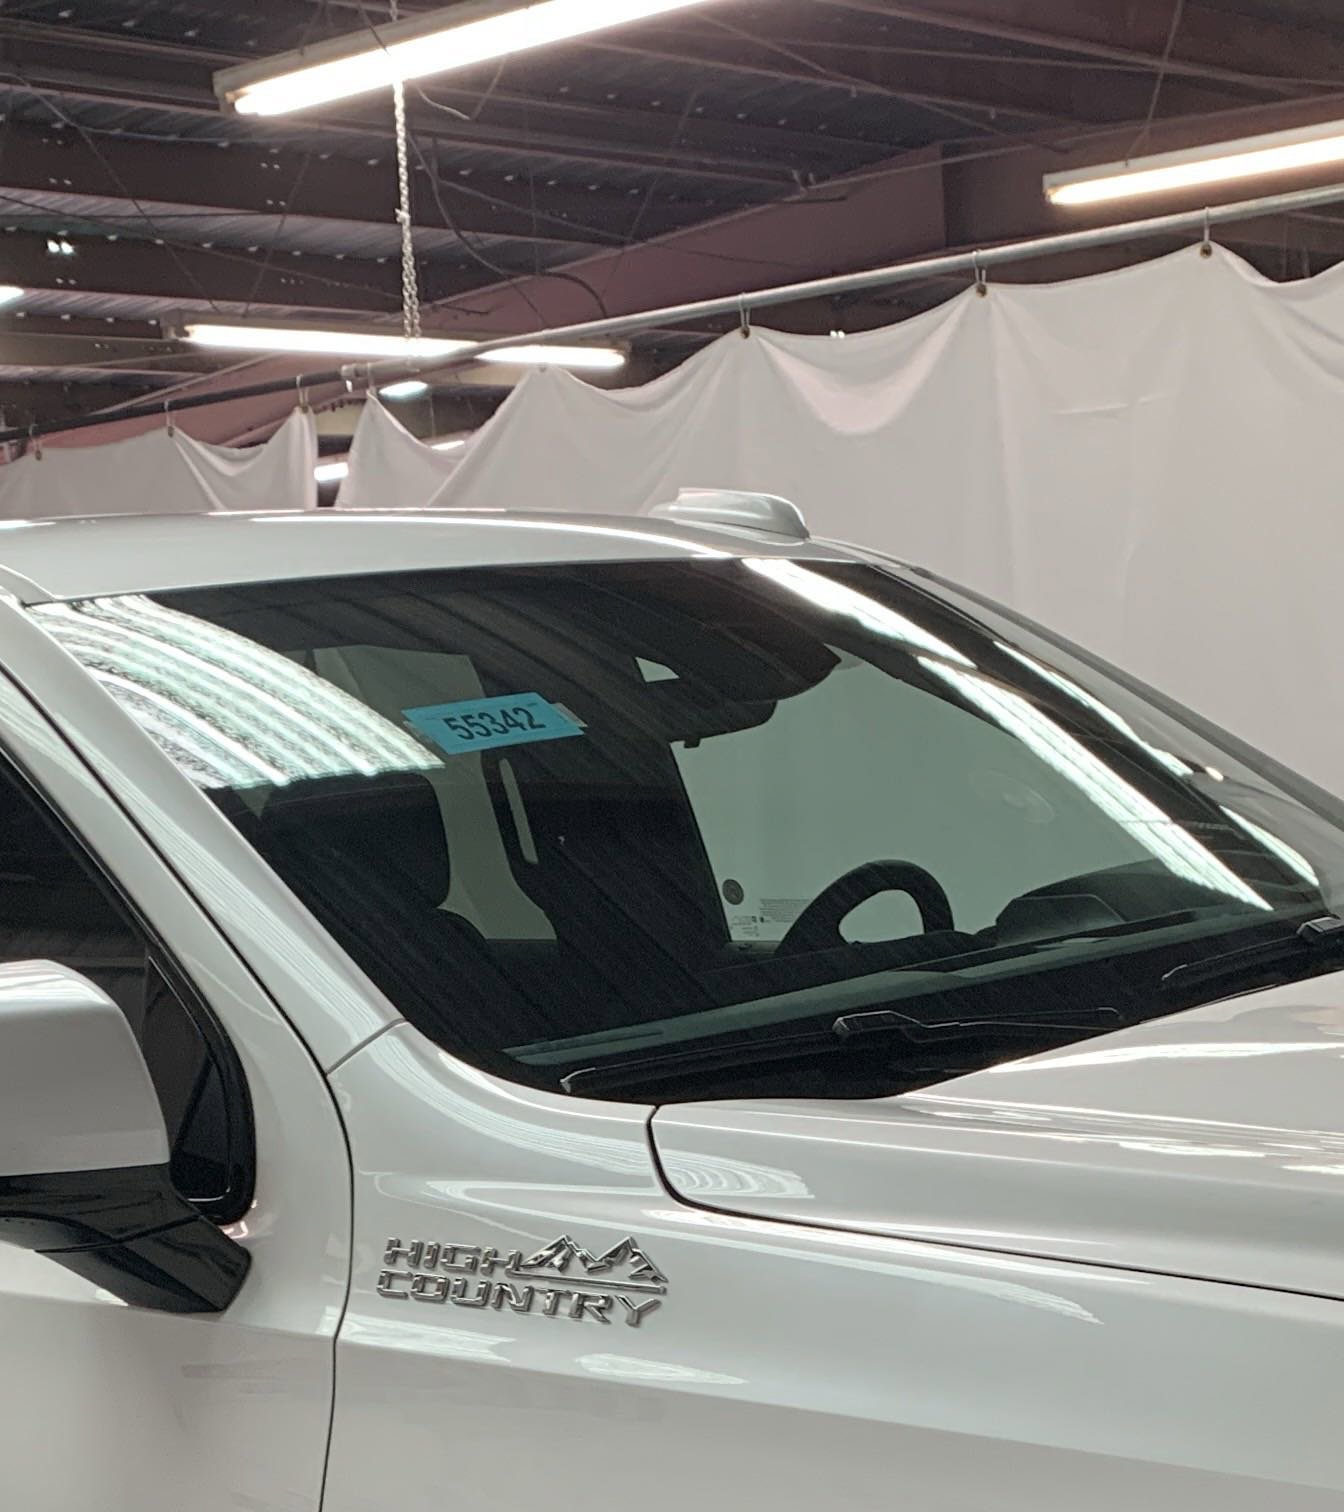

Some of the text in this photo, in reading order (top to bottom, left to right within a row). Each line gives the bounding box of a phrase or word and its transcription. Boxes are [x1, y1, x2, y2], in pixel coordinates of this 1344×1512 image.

[442, 706, 546, 741] 55342
[383, 1236, 522, 1276] HIGH
[376, 1269, 662, 1328] COUNTRY
